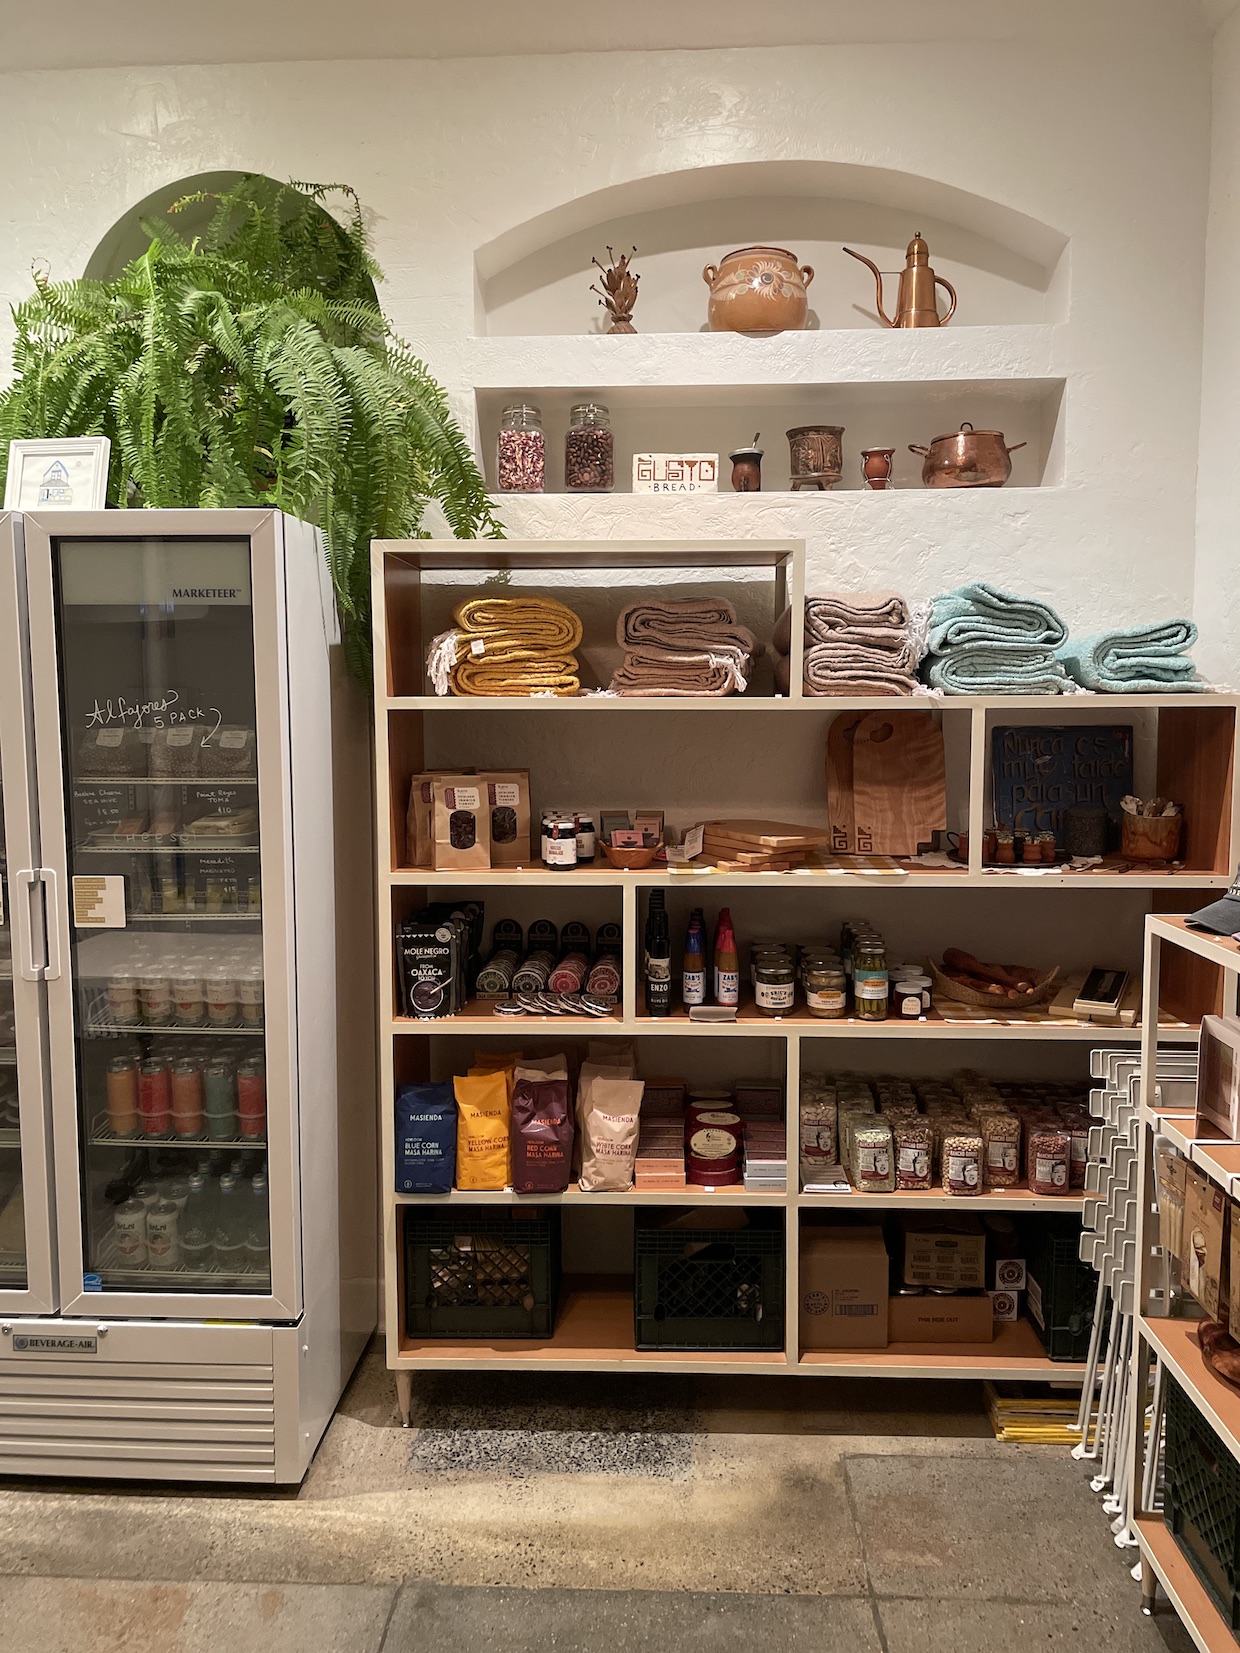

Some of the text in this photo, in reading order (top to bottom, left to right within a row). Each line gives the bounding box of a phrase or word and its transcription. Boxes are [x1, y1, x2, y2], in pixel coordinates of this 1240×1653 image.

[637, 456, 715, 481] GUSTO
[86, 690, 179, 729] Alfajores
[154, 707, 205, 729] 5 PACK
[404, 947, 450, 955] MOLE NEGRO
[410, 968, 443, 977] OAXACA
[650, 984, 669, 992] ENZO
[409, 1114, 443, 1122] MASIENDA
[470, 1110, 502, 1118] MASIENDA
[602, 1115, 634, 1123] MASIENDA
